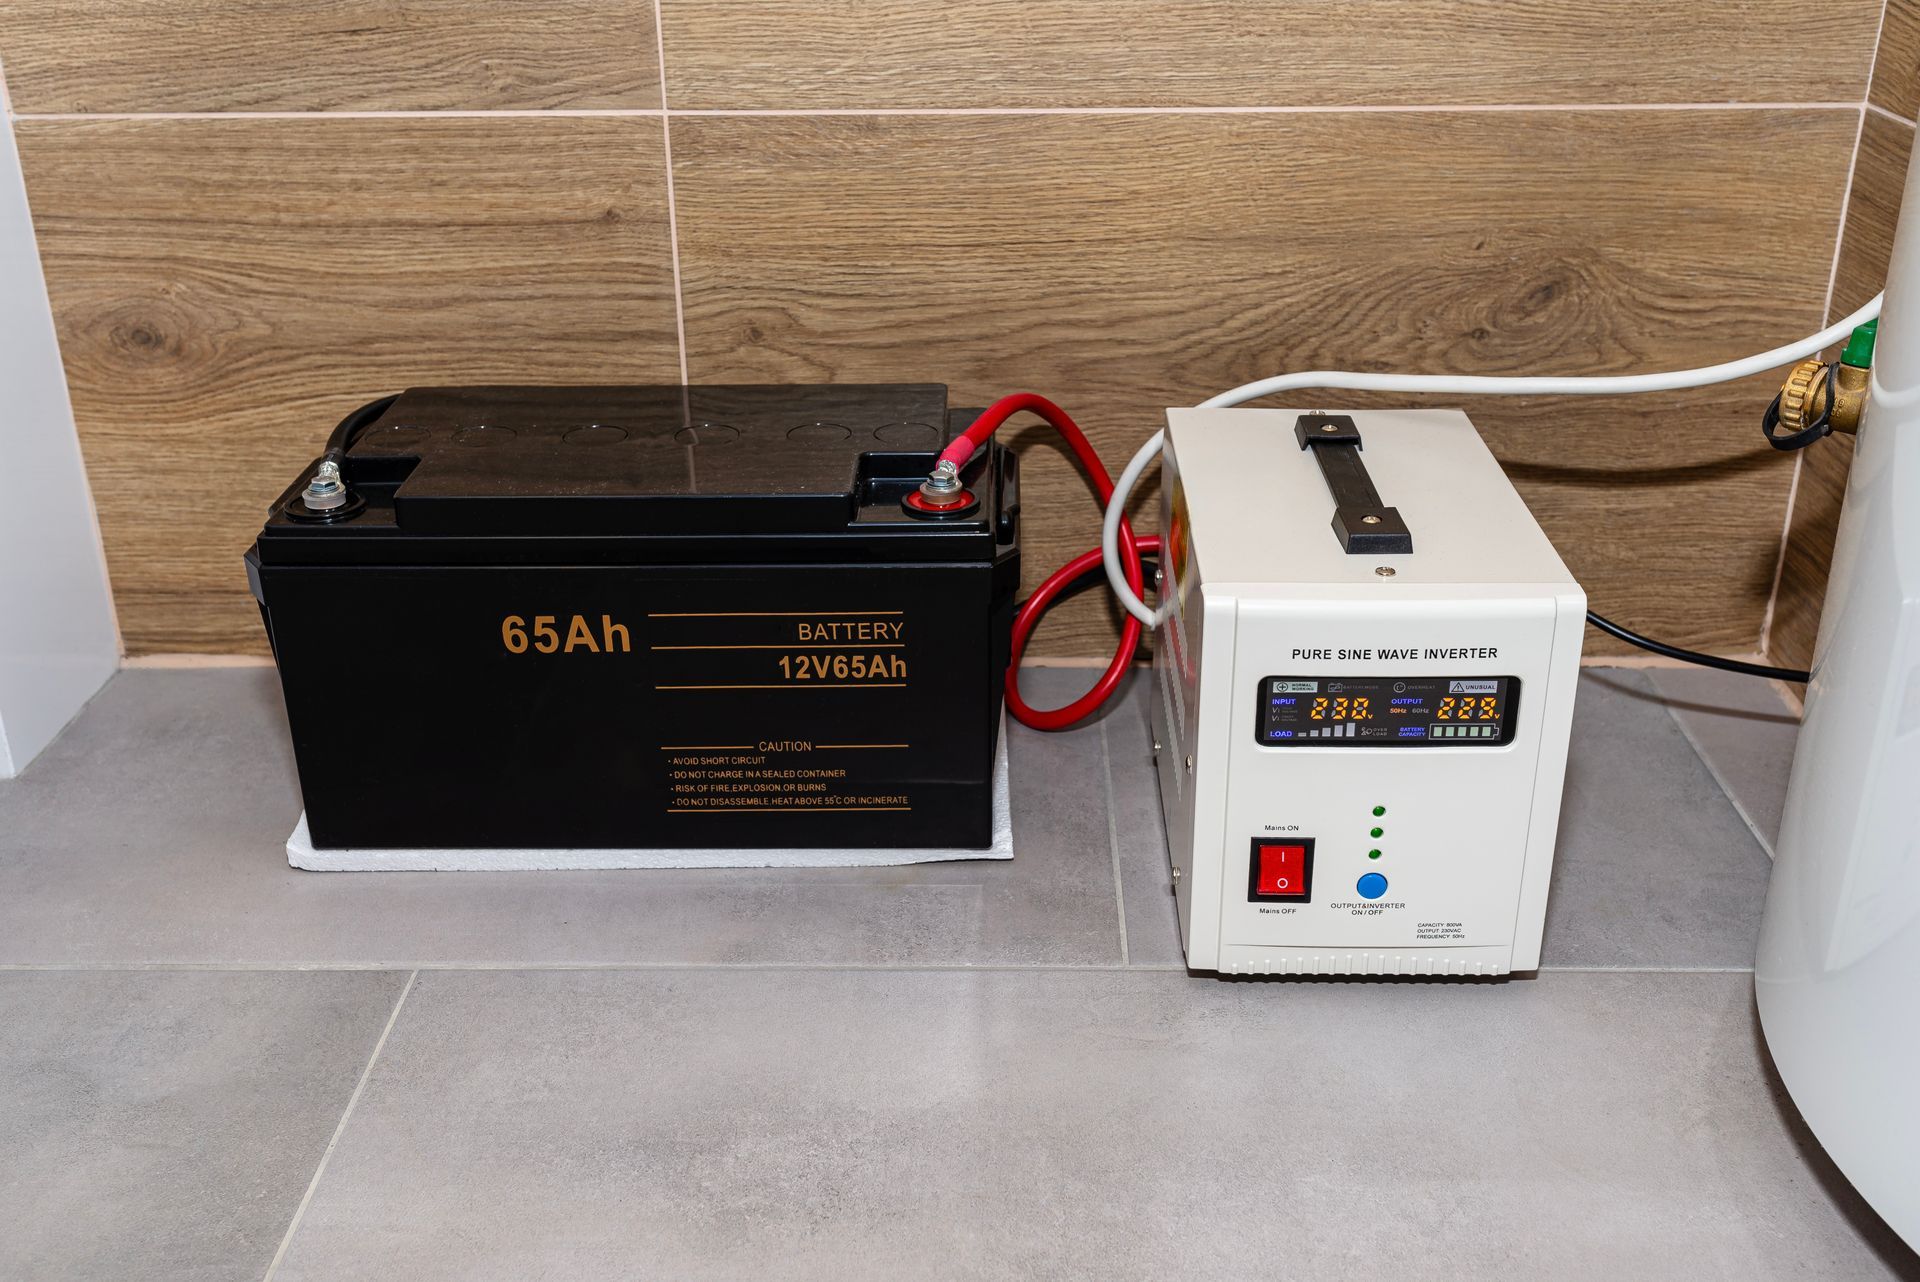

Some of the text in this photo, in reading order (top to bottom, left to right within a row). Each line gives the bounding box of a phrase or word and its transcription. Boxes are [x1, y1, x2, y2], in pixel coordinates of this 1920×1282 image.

[501, 615, 631, 654] 65Ah
[798, 622, 904, 641] BATTERY
[1291, 647, 1498, 660] PURE SINE WAVE INVERTER
[778, 654, 908, 679] 12V65Ah
[758, 741, 812, 752] CAUTION
[673, 756, 766, 765] AVOID SHORT CIRCUIT
[674, 770, 846, 779] DO NOT CHARGE IN A SEALED CONTAINER
[676, 784, 696, 792] RISK
[697, 784, 709, 792] OF
[798, 783, 827, 792] BURNS
[676, 798, 690, 806] DO
[690, 798, 708, 806] NOT
[795, 796, 822, 805] ABOVE
[843, 796, 856, 804] OR
[858, 796, 909, 804] INCINERATE
